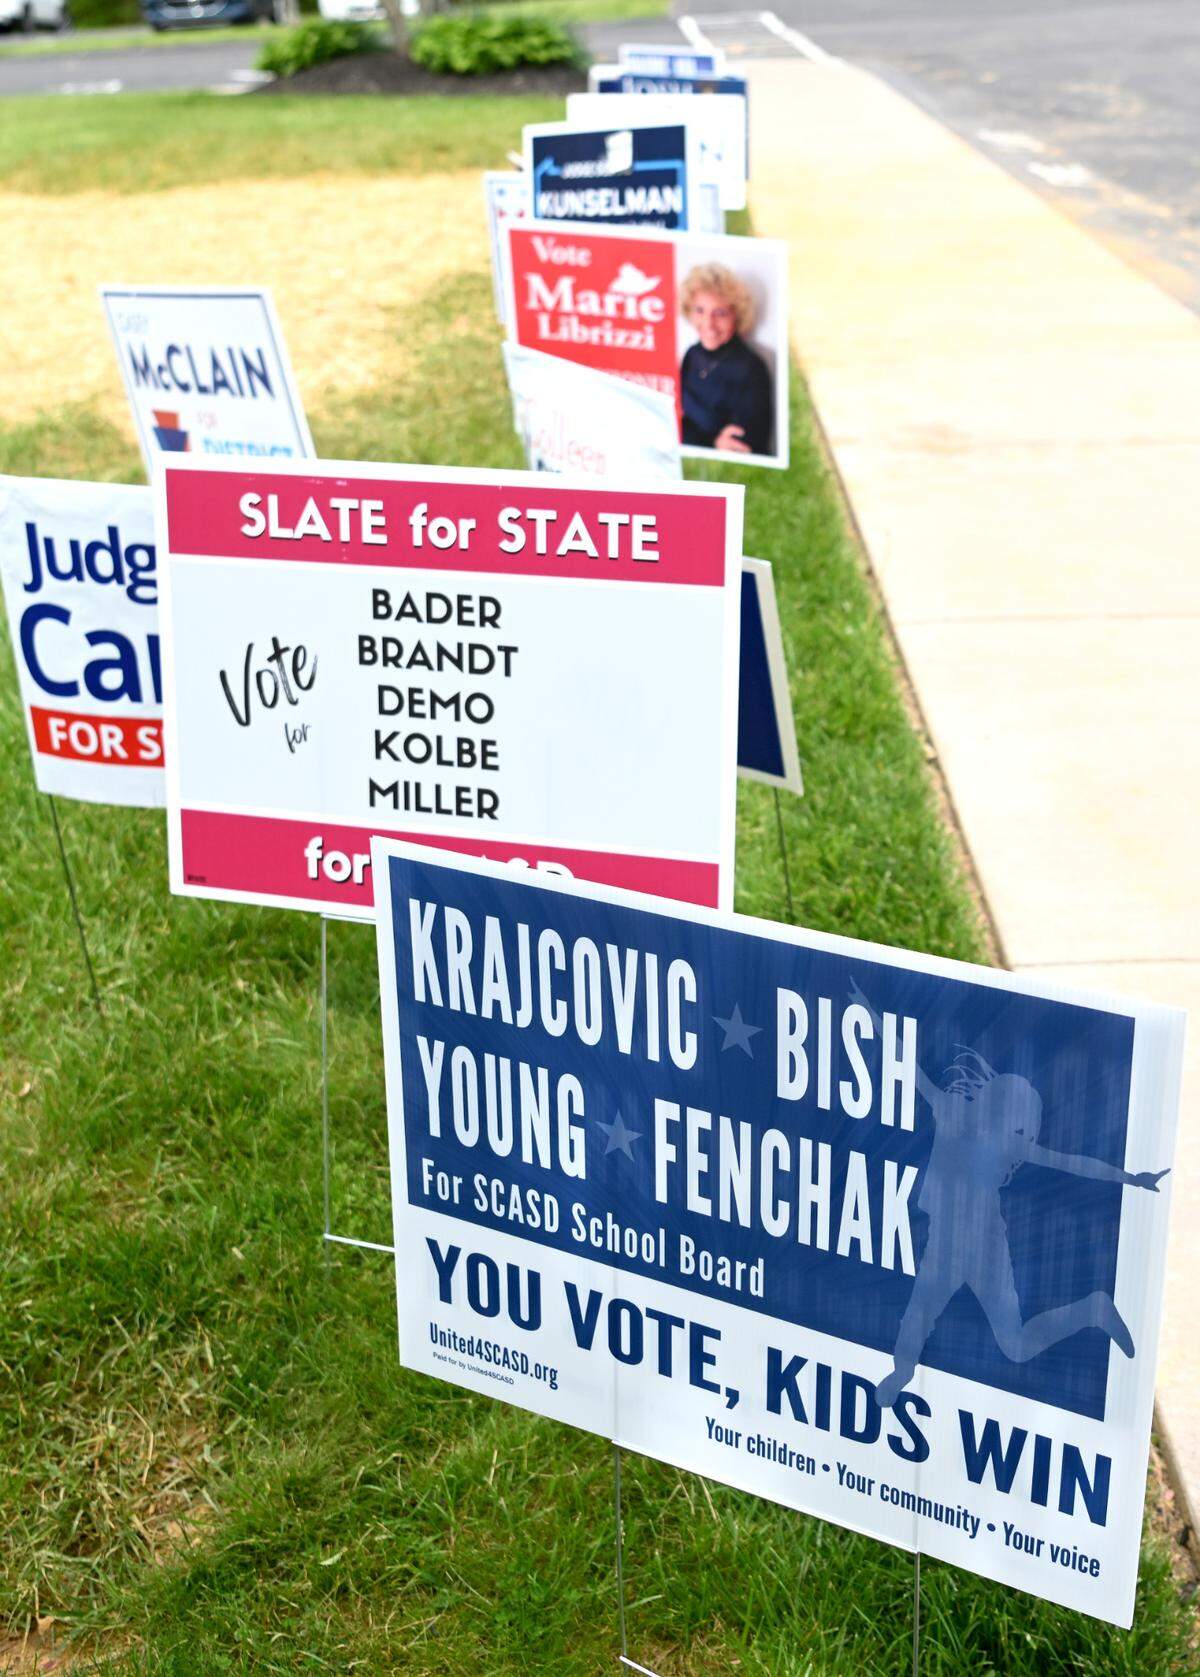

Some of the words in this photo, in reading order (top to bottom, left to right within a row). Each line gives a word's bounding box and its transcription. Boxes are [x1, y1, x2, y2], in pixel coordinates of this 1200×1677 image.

[540, 185, 683, 218] KUNSELMAN
[532, 236, 593, 267] Vote
[525, 272, 665, 322] Marie
[537, 313, 656, 351] Librizzi
[127, 342, 275, 399] McCLAIN
[239, 493, 387, 544] SLATE
[408, 503, 477, 551] for
[498, 508, 660, 562] STATE
[372, 588, 502, 629] BADER
[358, 635, 519, 677] BRANDT
[220, 636, 318, 727] Vote
[377, 684, 495, 724] DEMO
[48, 716, 128, 760] FOR
[285, 721, 312, 754] for
[373, 730, 500, 771] KOLBE
[368, 777, 500, 820] MILLER
[304, 836, 371, 885] for
[408, 897, 698, 1070] KRAJCOVIC
[776, 987, 918, 1132] BISH
[416, 1035, 586, 1180] YOUNG
[654, 1097, 919, 1277] FENCHAK
[422, 1158, 463, 1203] For
[474, 1172, 559, 1233] SCASD
[571, 1202, 666, 1268] School
[680, 1234, 766, 1298] Board
[429, 1322, 559, 1391] United4SCASD.org
[432, 1351, 448, 1362] Paid
[448, 1357, 457, 1365] for
[459, 1360, 466, 1370] by
[467, 1364, 515, 1385] United4SCASD
[425, 1237, 541, 1332] YOU
[564, 1281, 740, 1410] VOTE,
[766, 1345, 933, 1464] KIDS
[957, 1408, 1112, 1528] WIN
[705, 1416, 742, 1450] Your
[746, 1430, 816, 1476] children
[836, 1461, 874, 1497] Your
[879, 1482, 981, 1540] community
[1002, 1521, 1045, 1558] Your
[1050, 1543, 1101, 1578] voice
